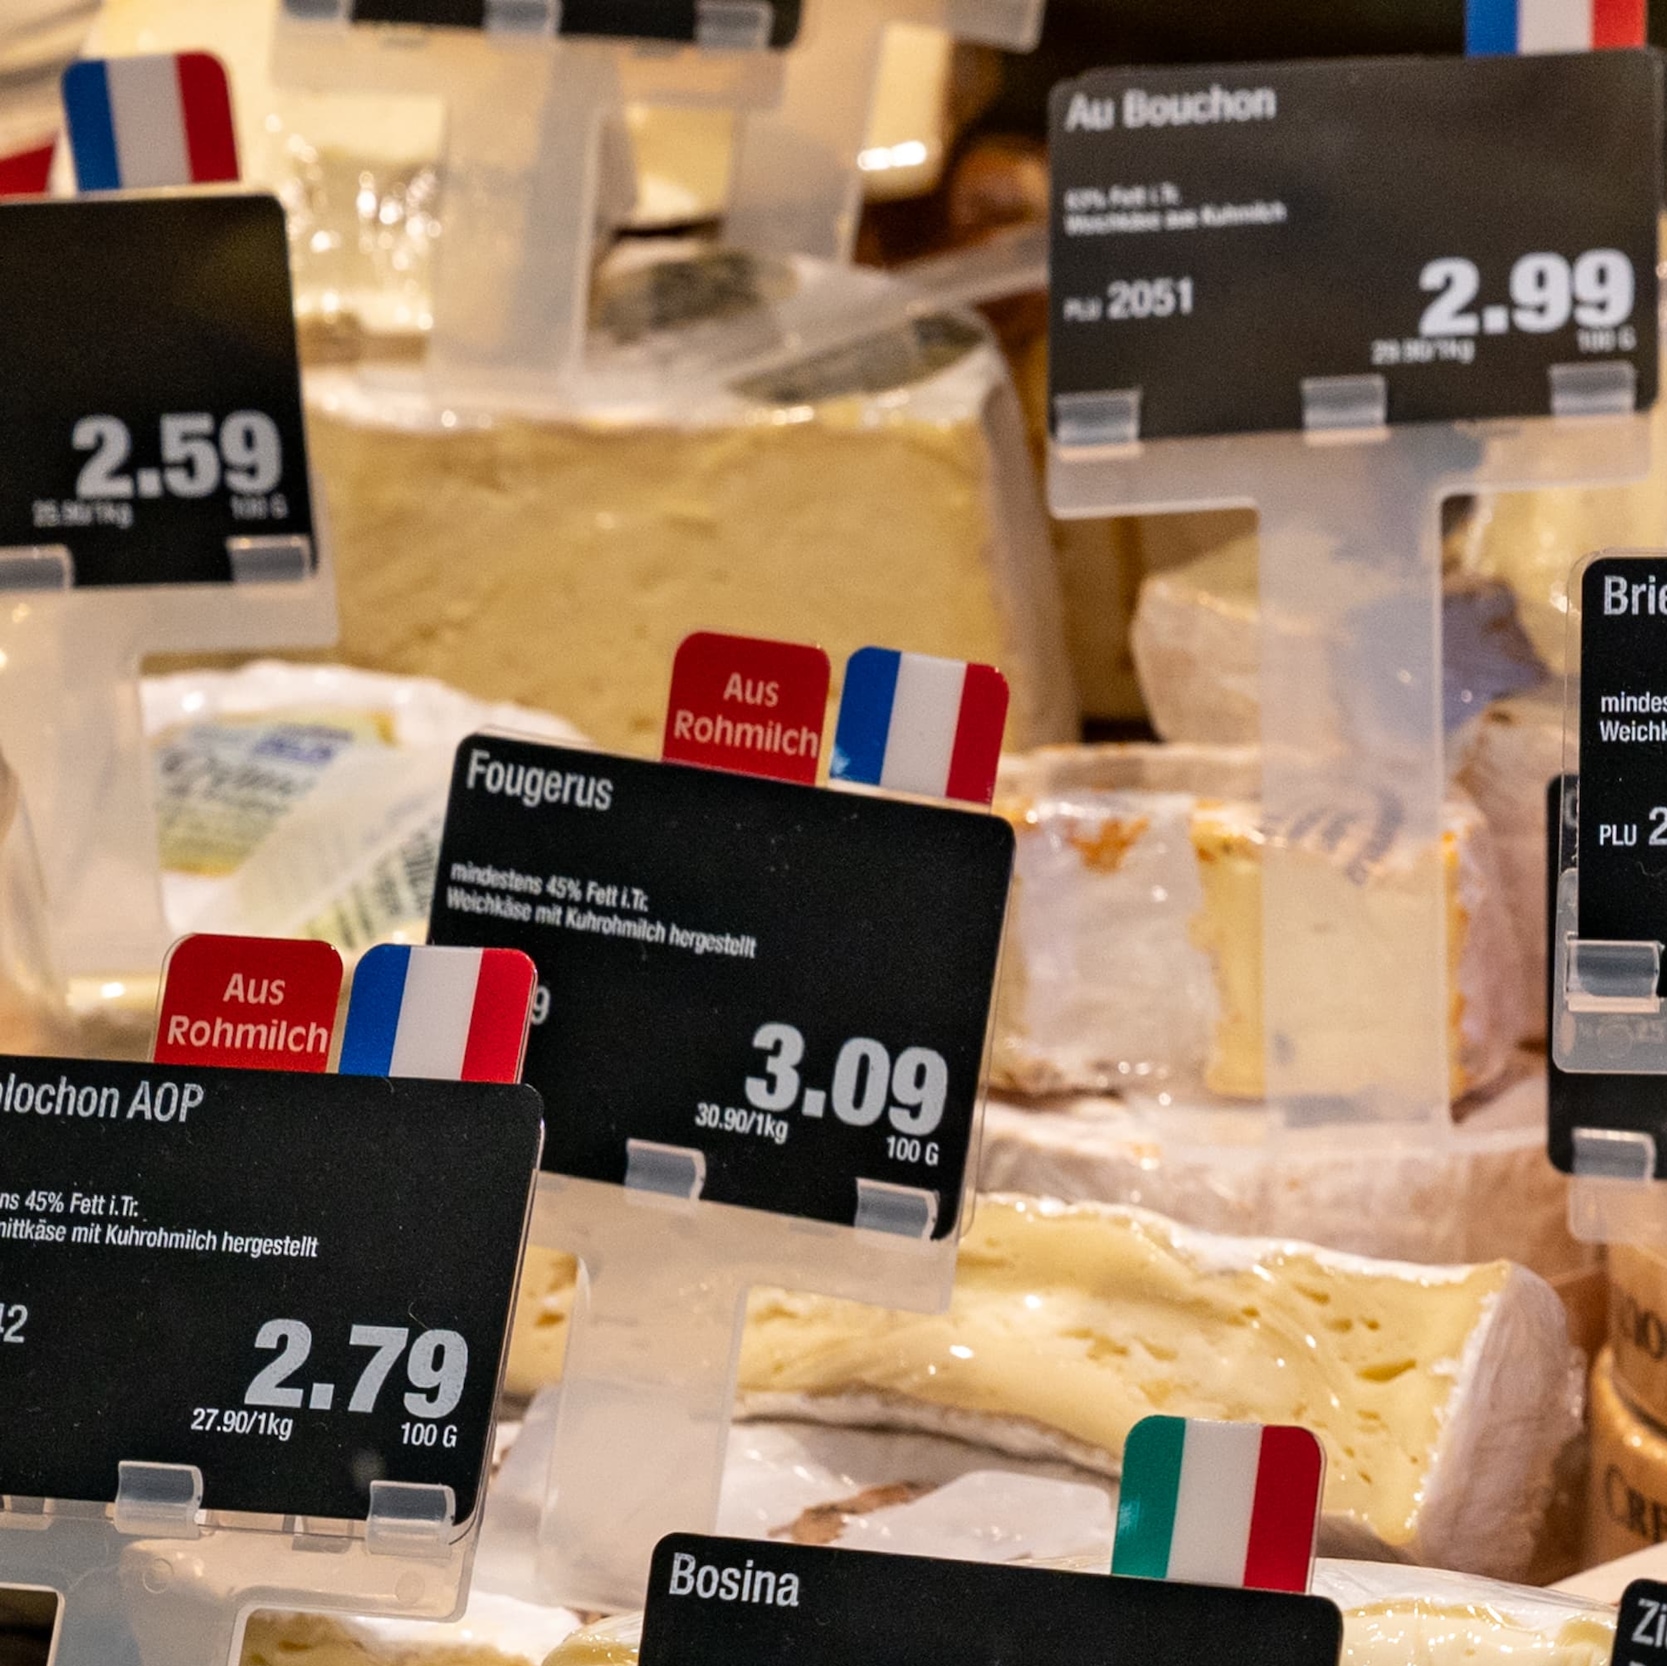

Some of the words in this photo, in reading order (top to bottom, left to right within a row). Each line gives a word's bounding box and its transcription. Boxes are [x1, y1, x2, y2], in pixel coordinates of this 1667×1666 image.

[1065, 93, 1115, 131] Au
[1122, 84, 1277, 129] Bouchon
[1418, 249, 1635, 338] 2.99
[72, 412, 281, 499] 2.59
[723, 672, 780, 708] Aus
[673, 709, 823, 761] Rohmilch
[466, 748, 614, 811] Fougerus
[1598, 823, 1638, 846] PLU
[450, 860, 543, 896] mindestens
[545, 874, 583, 902] 45%
[585, 880, 619, 908] Fett
[619, 885, 649, 913] i.Tr.
[446, 886, 533, 922] Weichkäse
[534, 903, 563, 927] mit
[564, 906, 667, 944] Kuhrohmilch
[668, 922, 758, 959] hergestellt
[222, 973, 286, 1006] Aus
[167, 1015, 334, 1058] Rohmilch
[125, 1079, 205, 1123] AOP
[744, 1022, 949, 1137] 3.09
[694, 1101, 789, 1145] 30.90/1kg
[886, 1134, 922, 1163] 100
[923, 1141, 940, 1166] G
[23, 1189, 65, 1213] 45%
[68, 1191, 106, 1216] Fett
[108, 1194, 139, 1218] i.Tr.
[70, 1221, 102, 1244] mit
[104, 1222, 218, 1251] Kuhrohmilch
[220, 1230, 319, 1259] hergestellt
[243, 1317, 469, 1419] 2.79
[189, 1406, 294, 1442] 27.90/1kg
[400, 1421, 438, 1447] 100
[441, 1424, 458, 1448] G
[668, 1551, 800, 1607] Bosina
